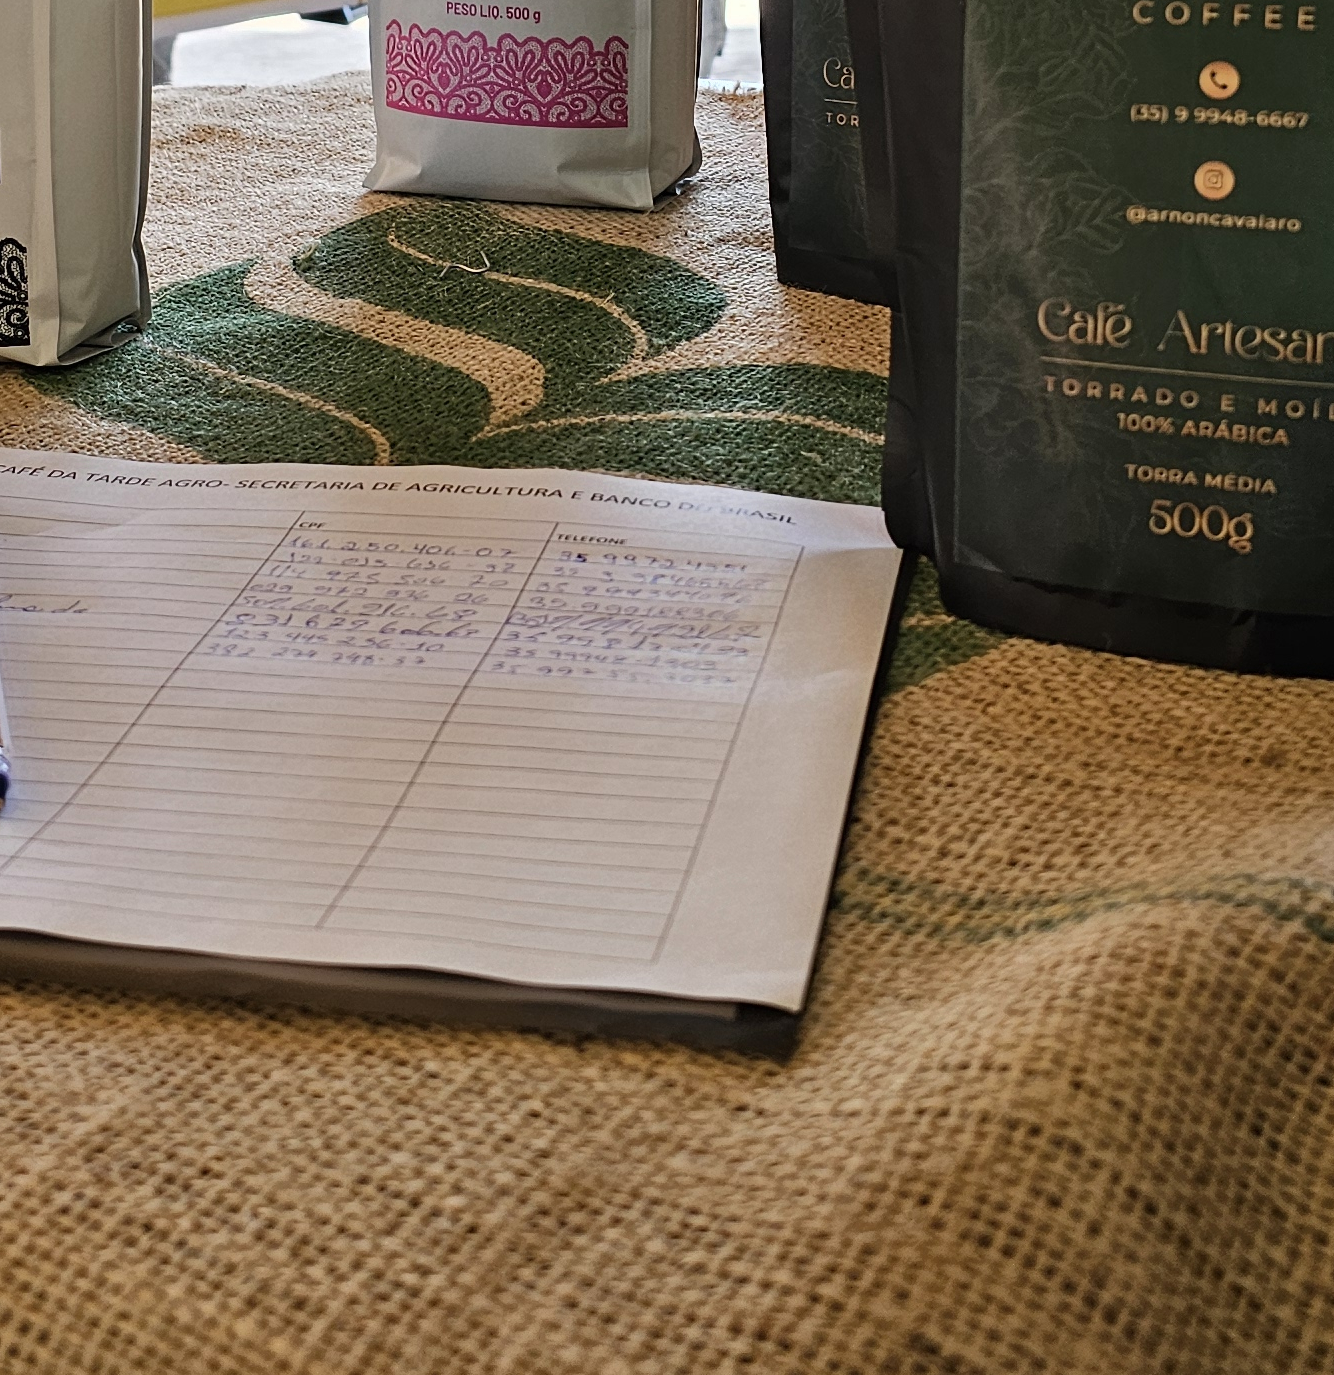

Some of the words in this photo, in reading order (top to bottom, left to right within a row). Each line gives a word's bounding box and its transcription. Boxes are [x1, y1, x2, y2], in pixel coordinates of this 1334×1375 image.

[446, 1, 477, 16] PESO
[480, 4, 503, 20] LIQ.
[506, 6, 530, 21] 500
[533, 10, 541, 24] g
[1131, 0, 1317, 31] COFFEE
[1174, 105, 1189, 124] 9
[1193, 106, 1310, 129] 9948-6667
[1126, 204, 1302, 233] @arnoncavalaro
[1037, 296, 1133, 349] Café
[1043, 375, 1200, 410] TORRADO
[1220, 394, 1236, 413] E
[1117, 412, 1176, 435] 100%
[1181, 419, 1290, 446] ARÁBICA
[46, 469, 77, 480] DA
[86, 472, 155, 487] TARDE
[157, 478, 229, 489] AGRO-
[234, 479, 365, 491] SECRETARIA
[371, 482, 402, 492] DE
[405, 482, 563, 500] AGRICULTURA
[570, 491, 583, 500] E
[589, 492, 671, 509] BANCO
[1124, 463, 1199, 486] TORRA
[1204, 471, 1277, 495] MÉDIA
[557, 533, 629, 546] TELEFONE
[1148, 499, 1255, 555] 500g
